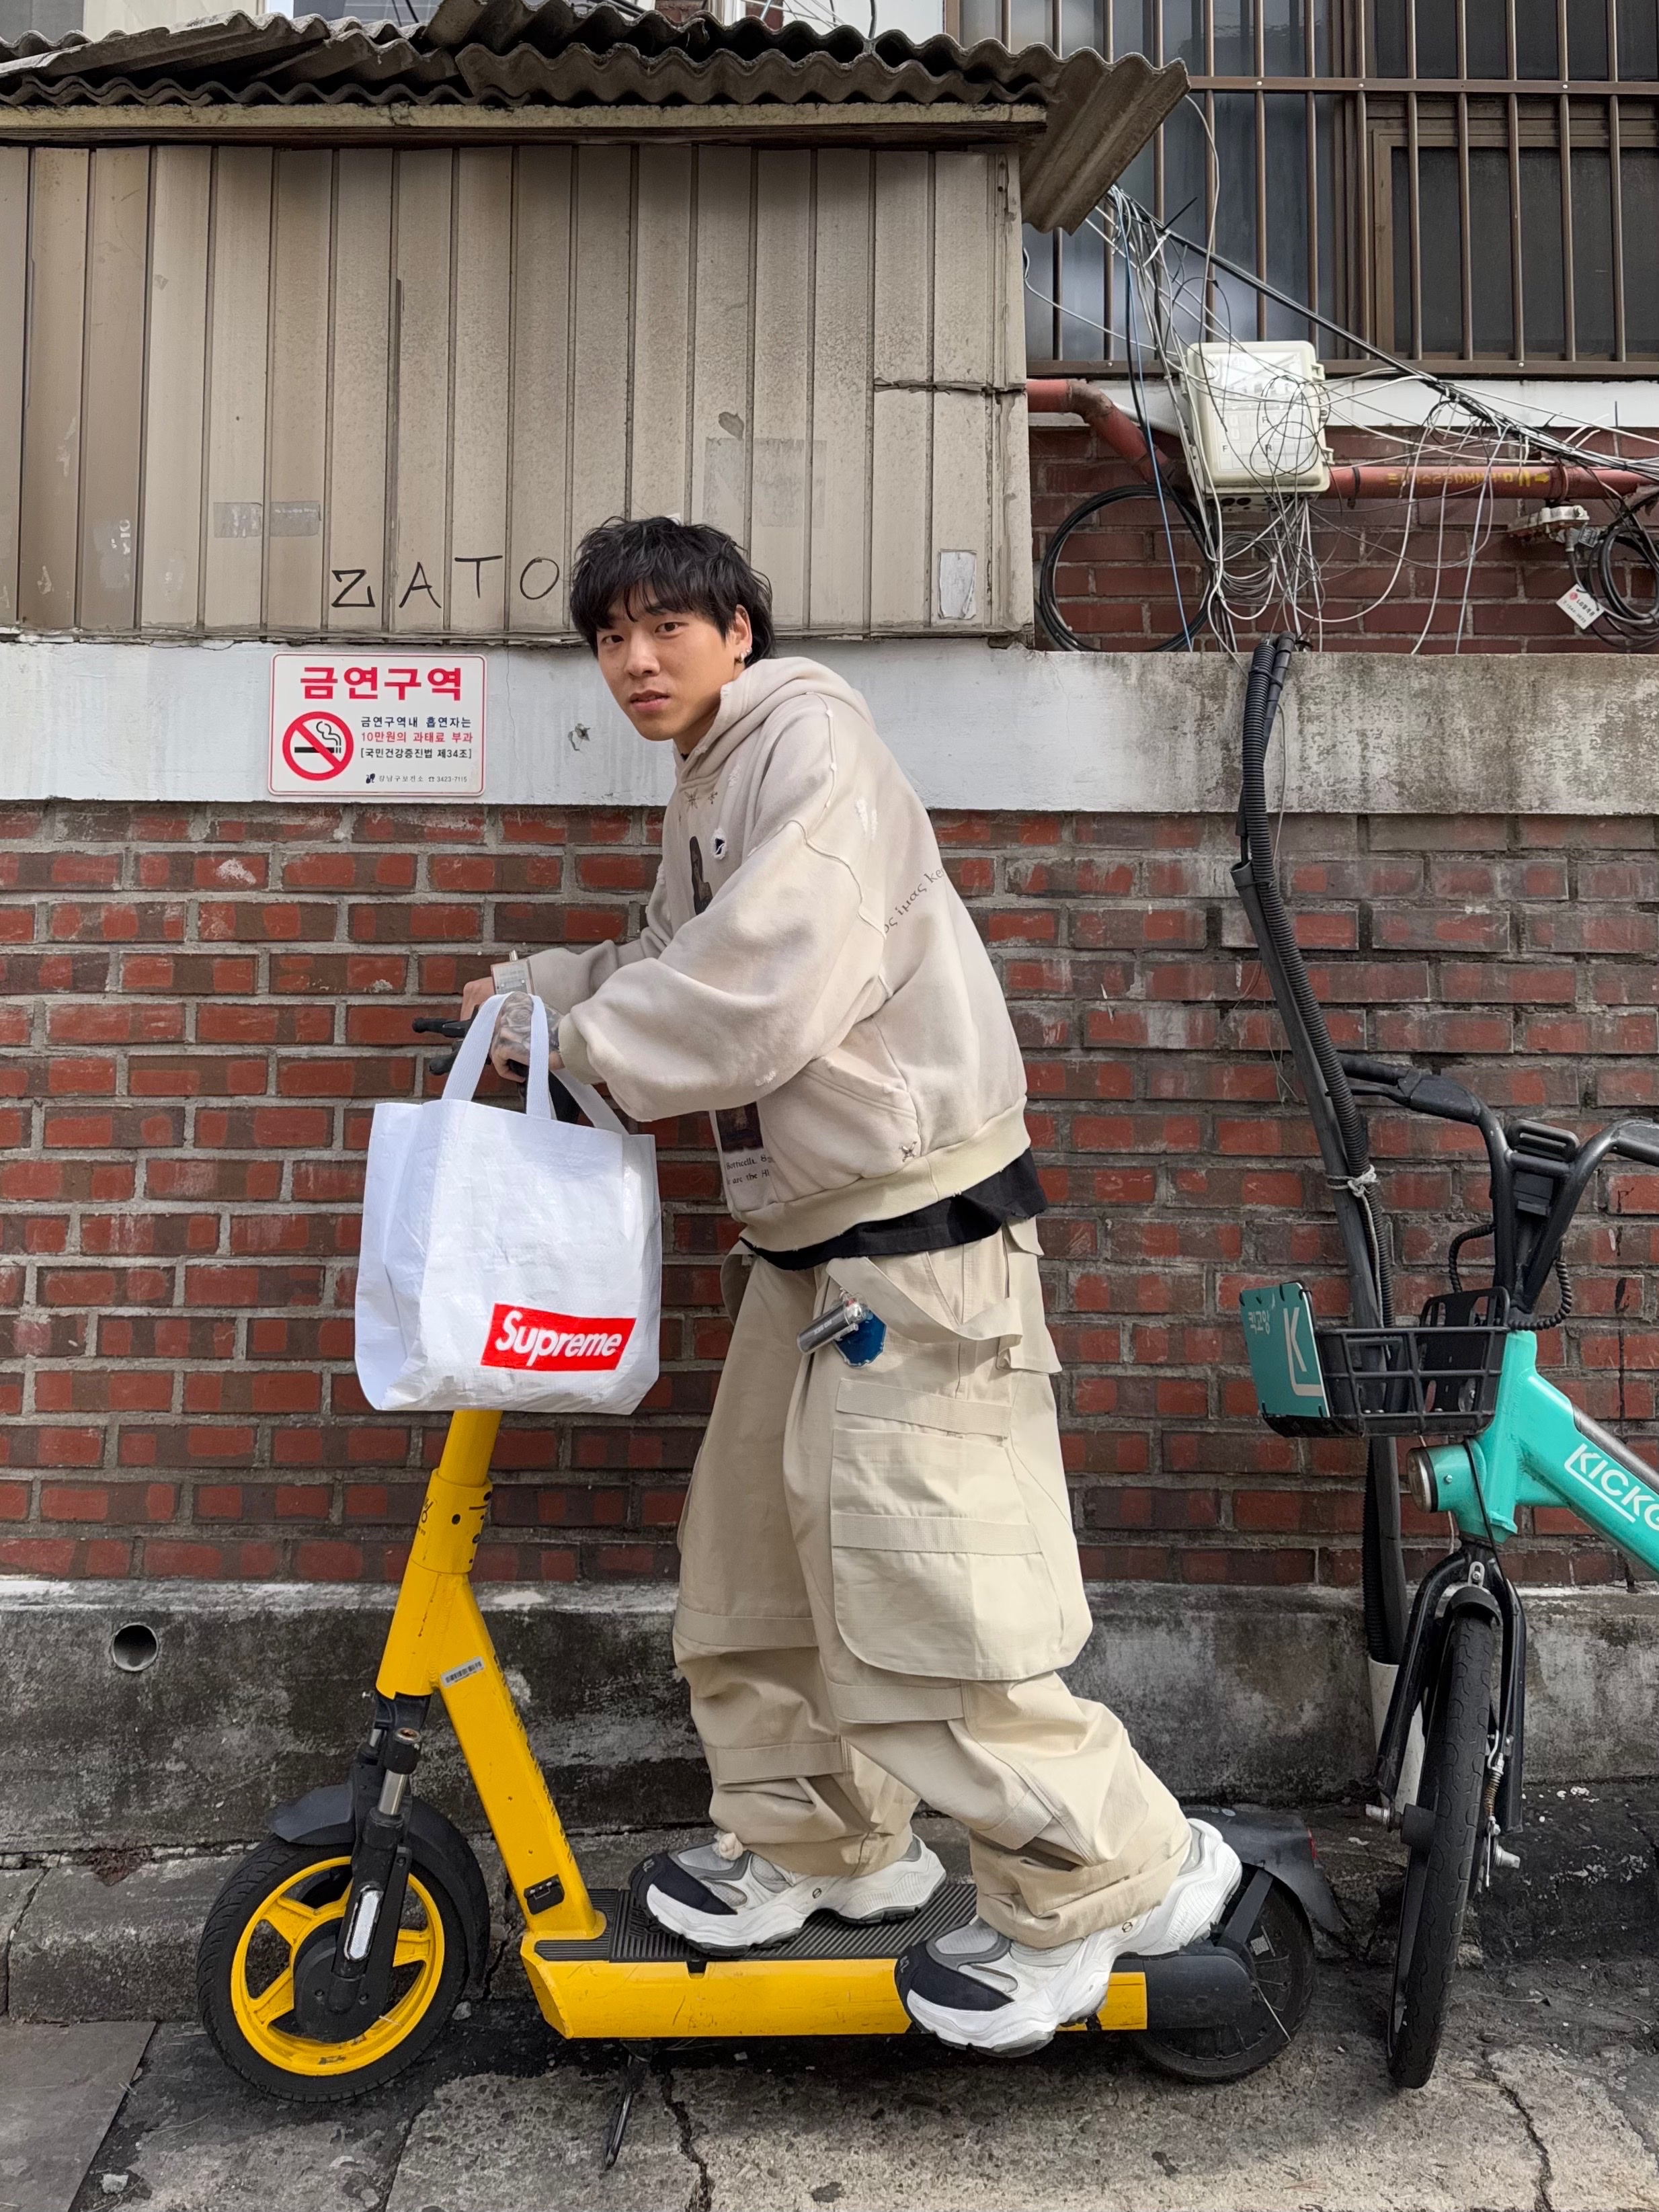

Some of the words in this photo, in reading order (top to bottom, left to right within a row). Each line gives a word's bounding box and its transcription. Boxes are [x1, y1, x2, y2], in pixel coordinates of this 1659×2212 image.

[331, 555, 560, 608] ZATO
[300, 667, 461, 701] 금연구역
[360, 716, 418, 728] 금연구역내
[426, 716, 471, 728] 흡연자는
[361, 731, 407, 743] 10만원의
[413, 731, 446, 743] 과태료
[452, 732, 473, 743] 부과
[361, 747, 433, 759] [국민건강증진법
[437, 748, 472, 760] 제34조]
[1248, 1310, 1270, 1335] 킥고잉
[495, 1310, 622, 1366] Supreme
